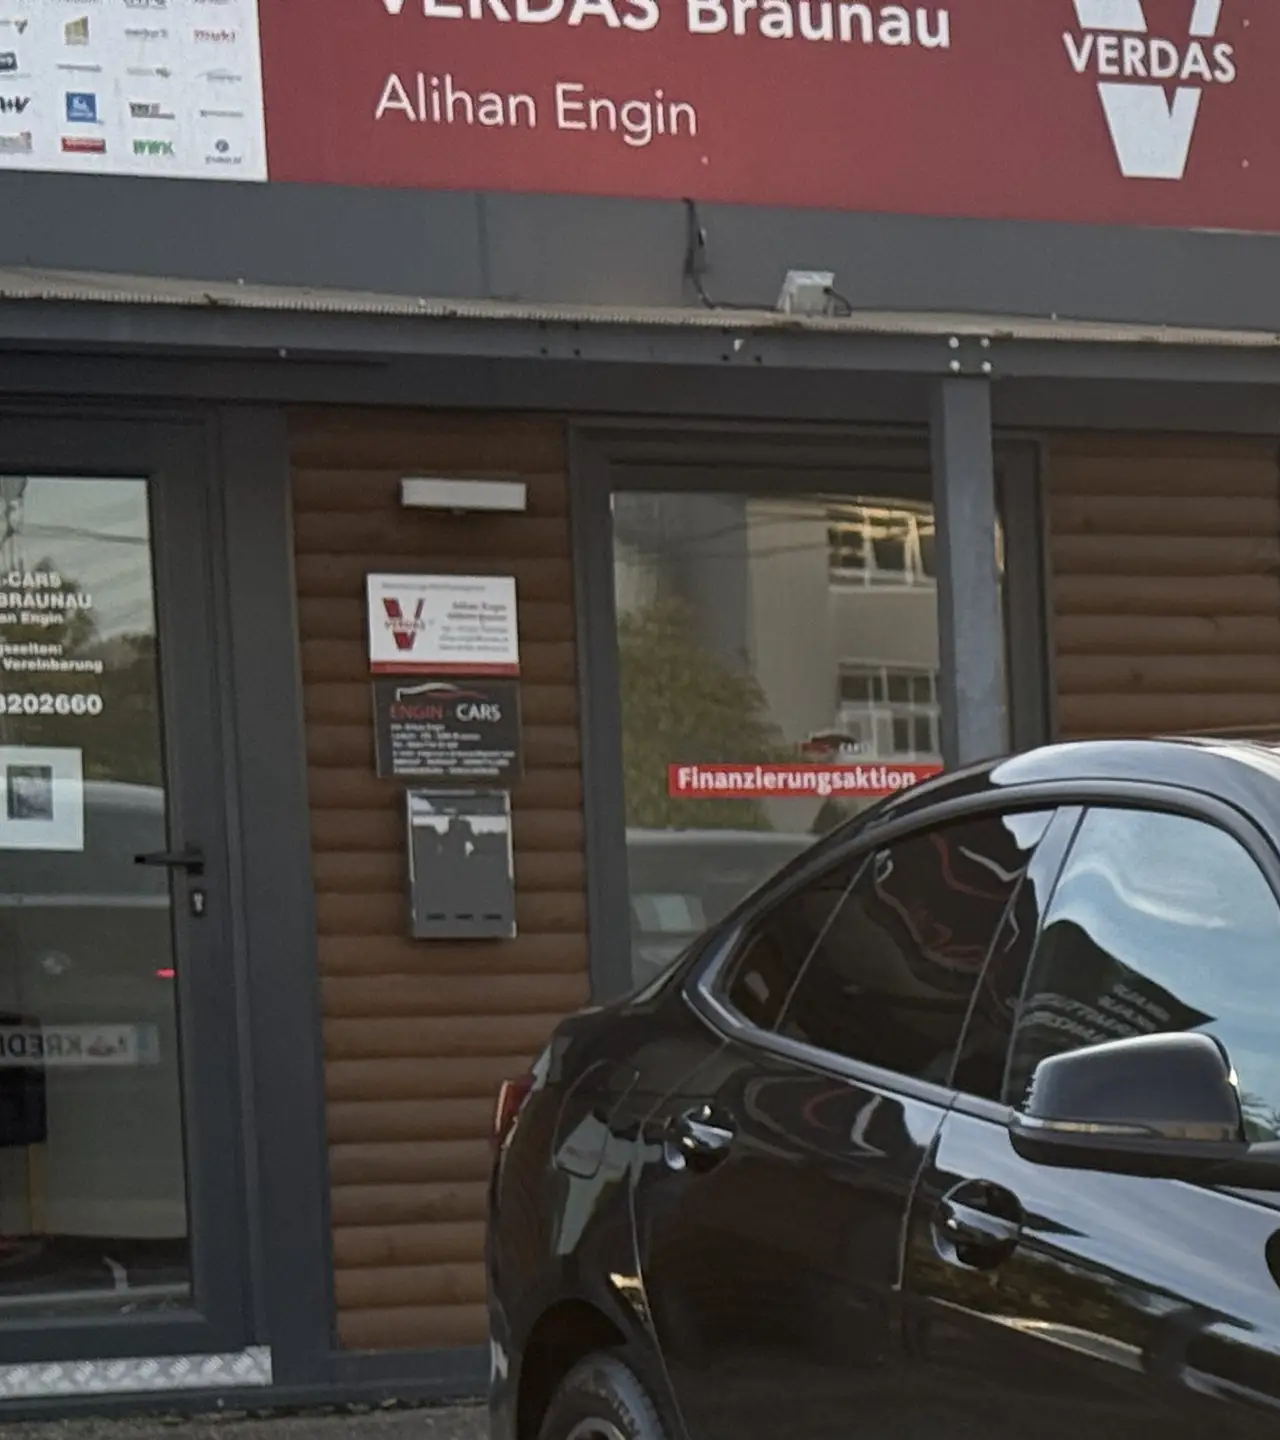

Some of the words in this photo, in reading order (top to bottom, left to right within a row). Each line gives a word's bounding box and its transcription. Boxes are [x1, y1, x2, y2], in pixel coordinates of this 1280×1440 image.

[384, 0, 660, 31] DAS
[687, 0, 950, 49] Braunau
[1062, 32, 1236, 84] VERDAS
[375, 71, 537, 128] Alihan
[555, 82, 698, 147] Engin
[456, 703, 502, 722] CARS
[677, 767, 917, 796] Finanzierungsaktion
